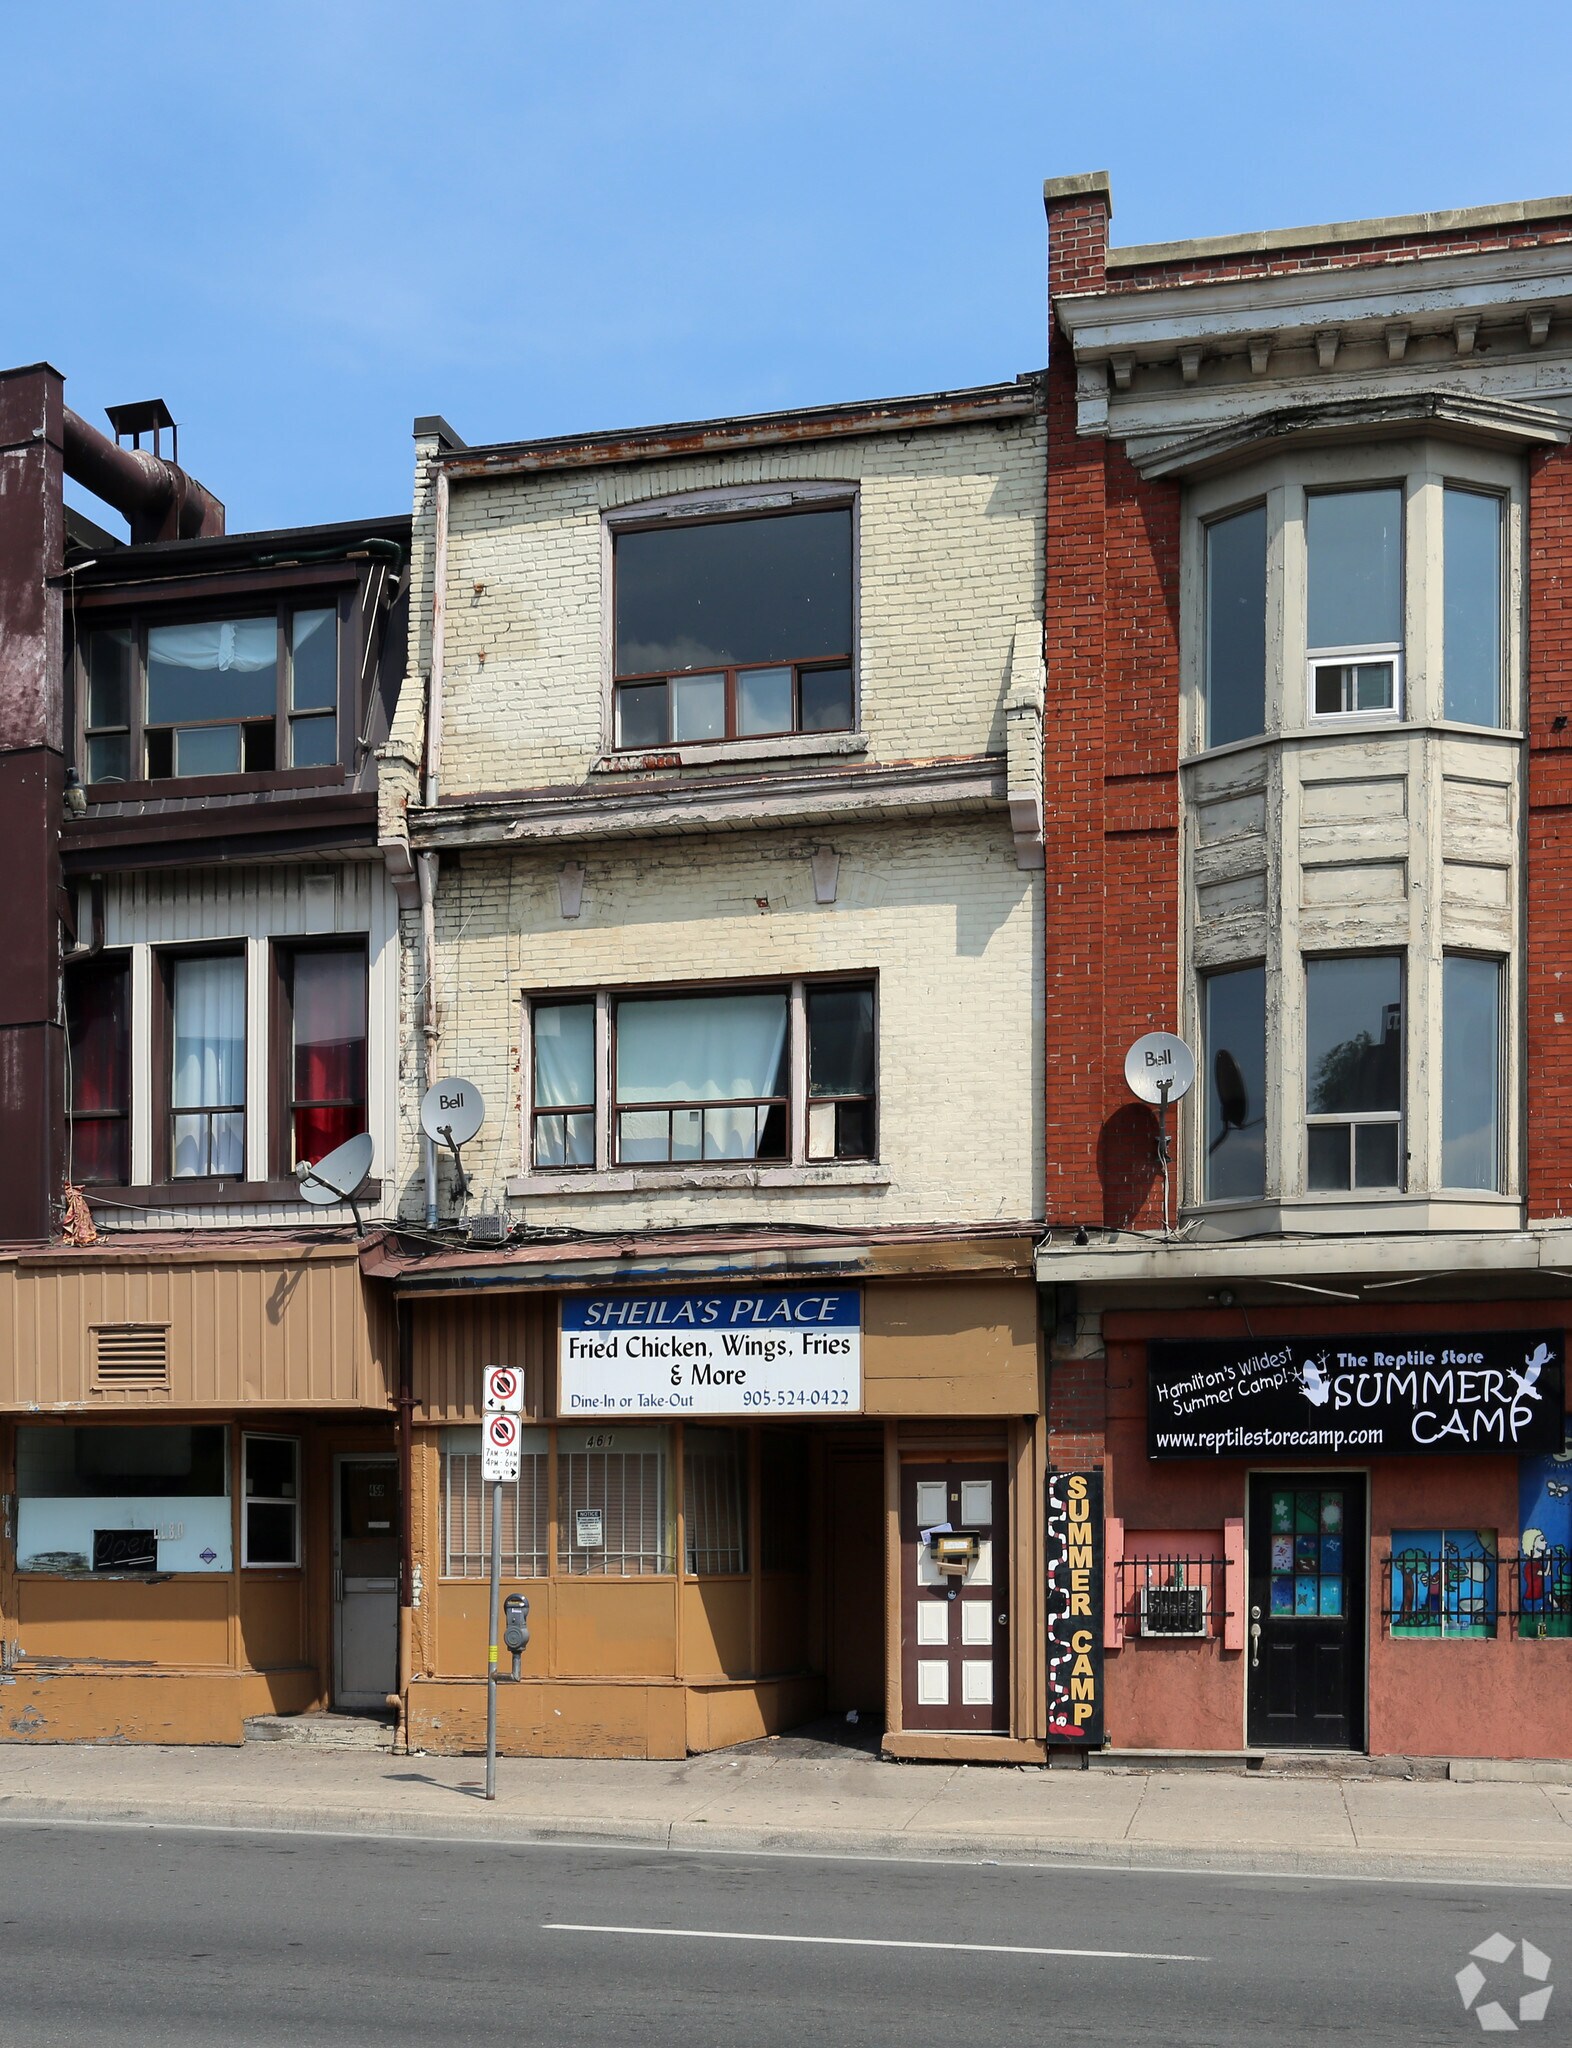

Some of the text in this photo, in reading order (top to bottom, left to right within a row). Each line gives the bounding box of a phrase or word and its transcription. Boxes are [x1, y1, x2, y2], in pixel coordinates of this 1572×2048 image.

[1144, 1049, 1172, 1067] Bell
[439, 1092, 464, 1110] Bell
[584, 1297, 839, 1326] SHEILA'S PLACE
[569, 1333, 851, 1362] Fried Chicken, Wings, Fries
[1337, 1350, 1484, 1370] The Reptile Store
[670, 1363, 746, 1386] & More
[1156, 1345, 1293, 1402] Hamilton's Wildest
[571, 1390, 849, 1408] Dine-In or Take-Out 905-524-0422
[1173, 1367, 1289, 1417] Summer Camp!
[1334, 1369, 1513, 1411] SUMMER
[1411, 1404, 1533, 1444] CAMP
[586, 1434, 613, 1448] 461
[1156, 1427, 1384, 1453] www.reptilestorecamp.com
[96, 1532, 156, 1562] Open
[1067, 1475, 1095, 1727] SUMMER CAMP
